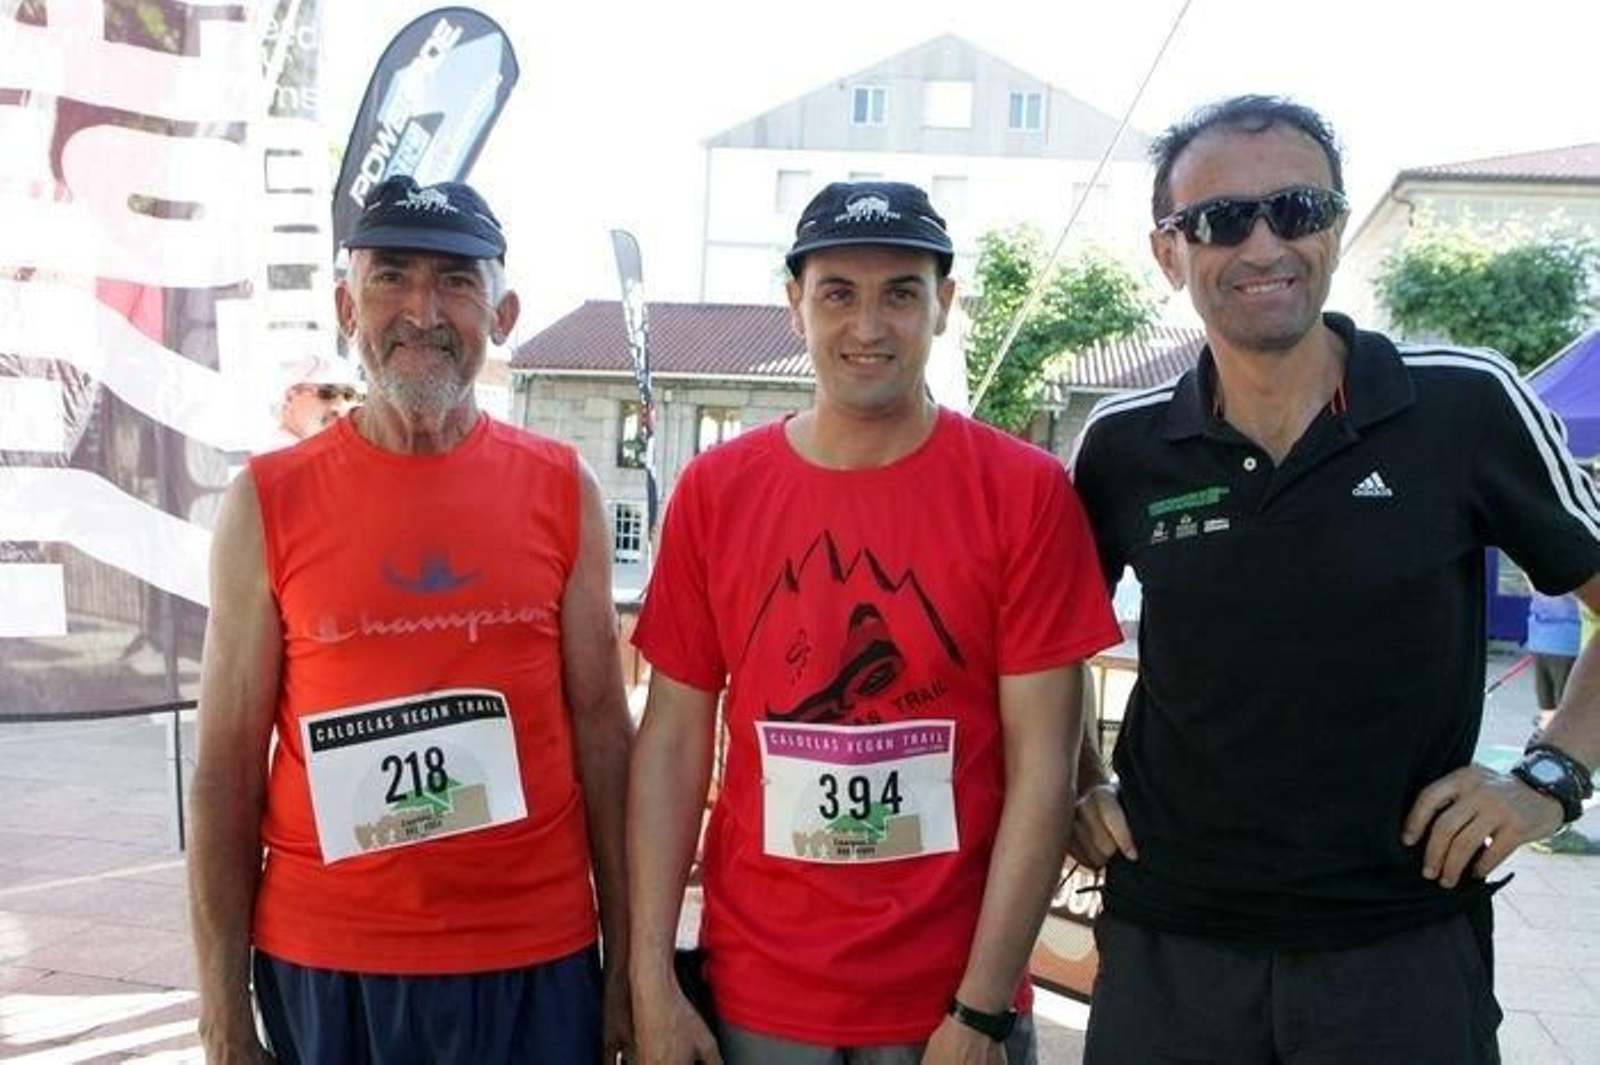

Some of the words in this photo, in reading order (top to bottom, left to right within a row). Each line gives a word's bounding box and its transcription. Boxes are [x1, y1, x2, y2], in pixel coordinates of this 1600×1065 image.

[349, 17, 464, 208] POWEDE
[315, 716, 395, 743] CALDELAS
[402, 704, 450, 725] VEGAN
[457, 700, 500, 715] TRAIL
[769, 732, 840, 752] CALDELAS
[846, 738, 895, 754] VEGAN
[902, 731, 945, 747] TRAIL
[380, 746, 450, 804] 218
[818, 769, 904, 821] 394
